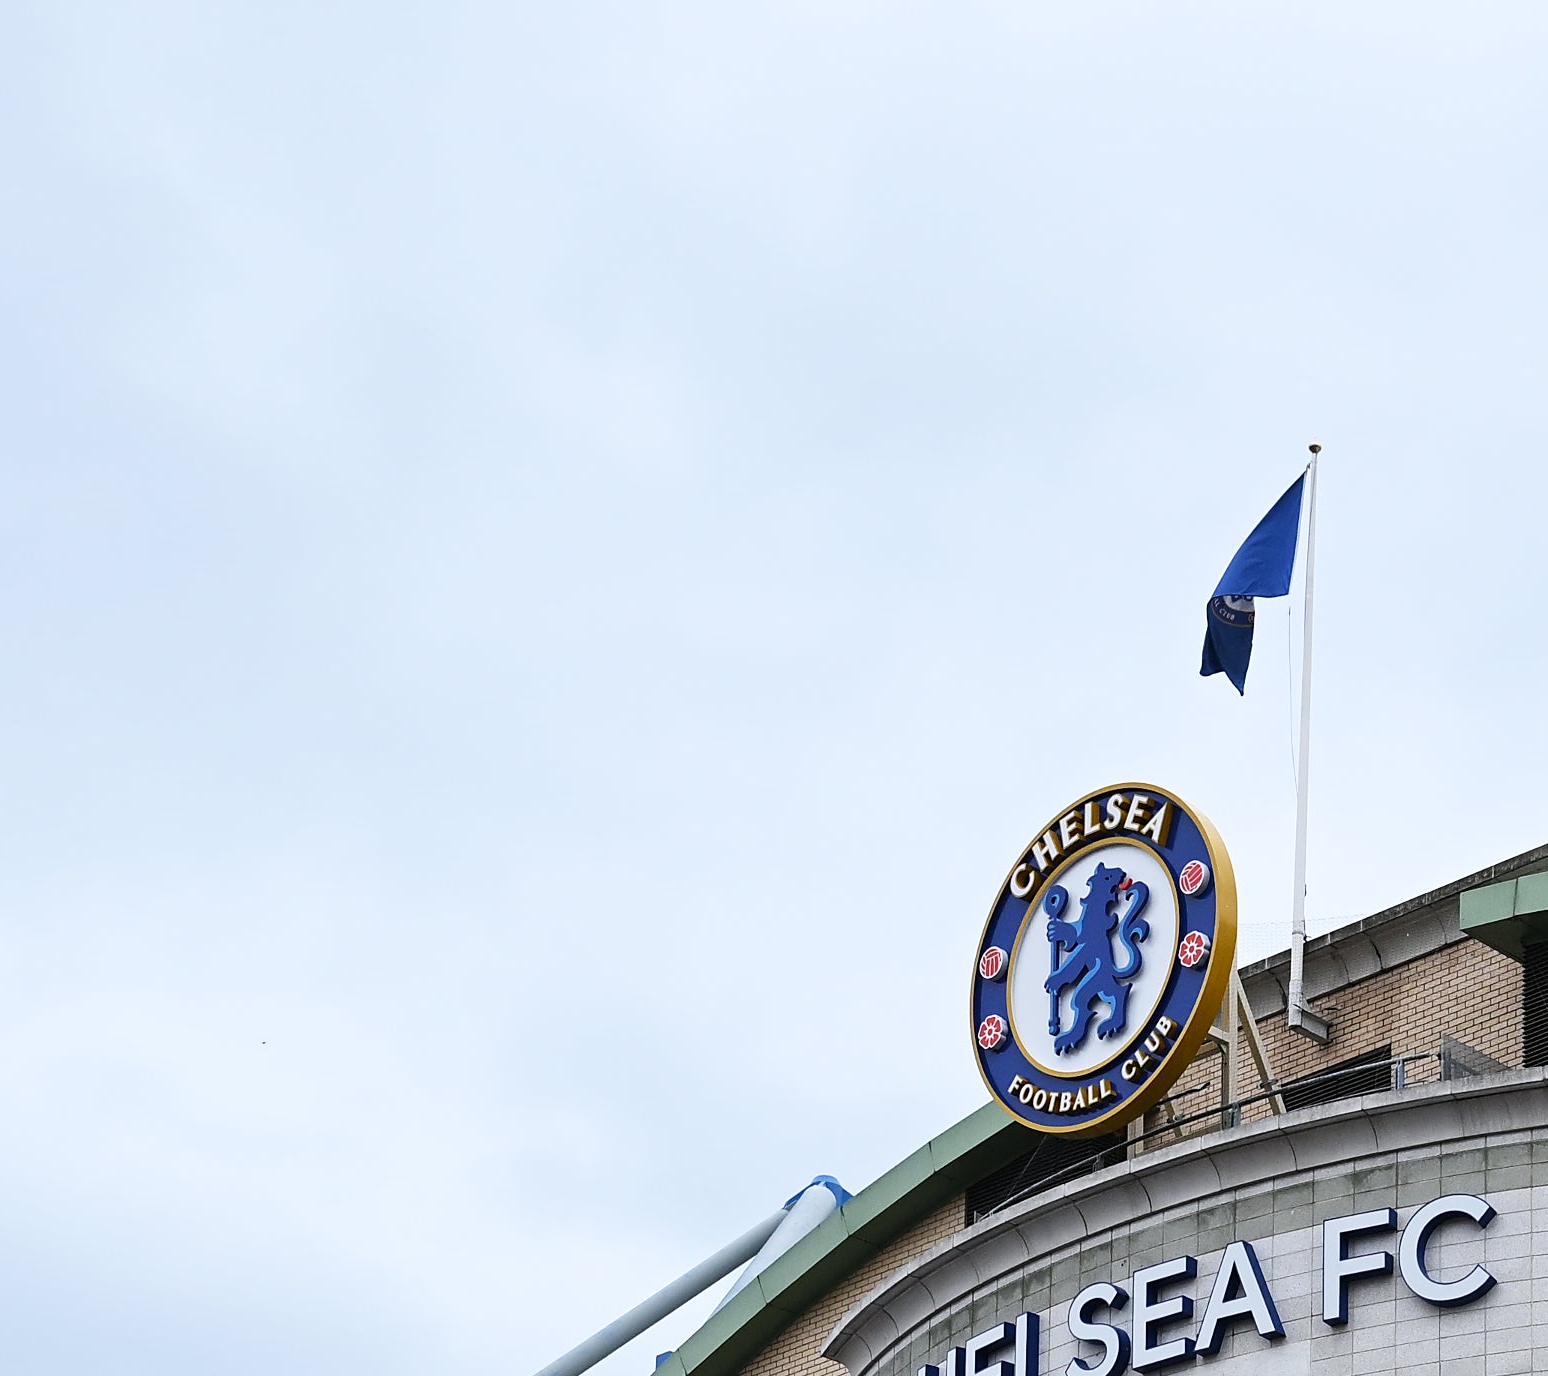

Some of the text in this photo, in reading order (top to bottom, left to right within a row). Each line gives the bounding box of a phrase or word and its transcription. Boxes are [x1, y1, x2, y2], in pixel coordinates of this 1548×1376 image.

[1009, 793, 1168, 899] CHELSEA
[1007, 1014, 1173, 1113] FOOTBALL CLUB
[1322, 1193, 1498, 1327] FC
